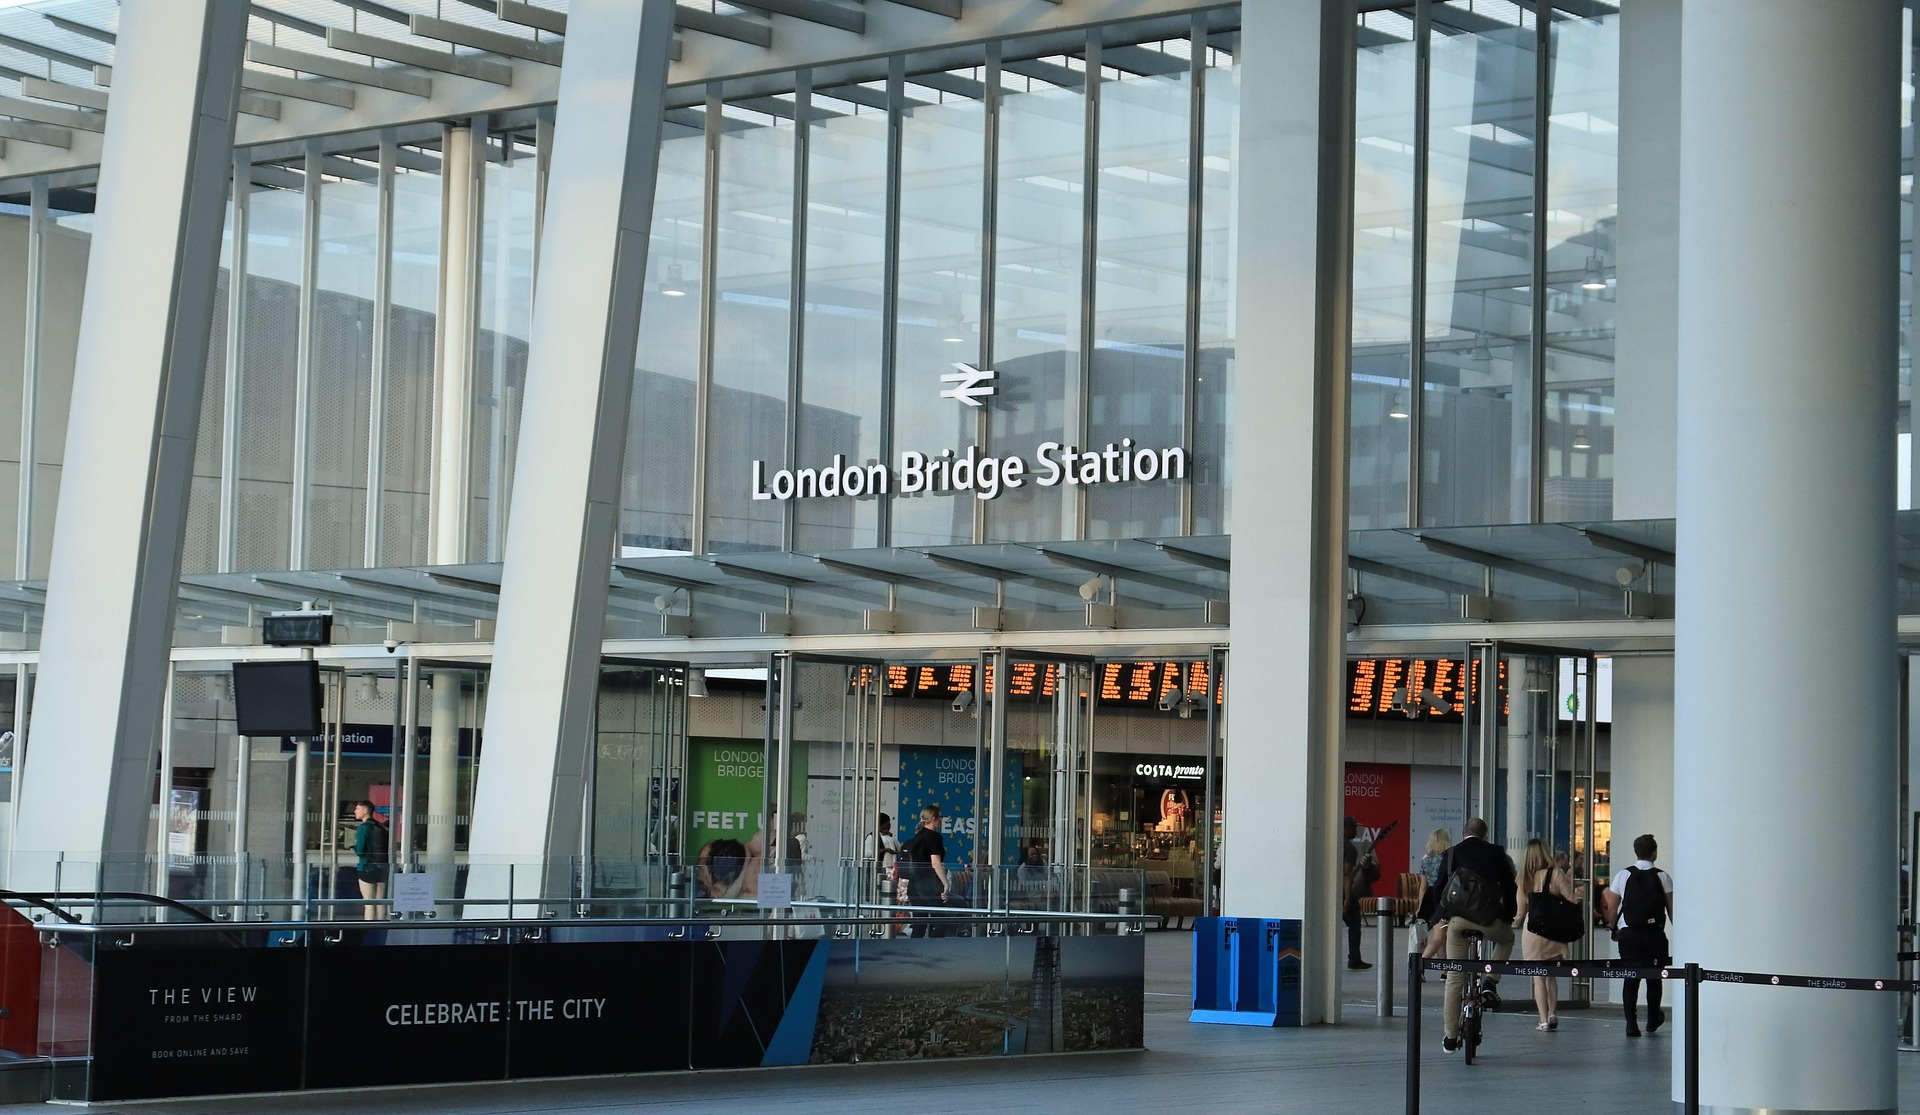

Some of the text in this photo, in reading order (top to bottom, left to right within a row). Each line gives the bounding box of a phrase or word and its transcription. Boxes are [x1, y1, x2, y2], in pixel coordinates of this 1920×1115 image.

[753, 437, 1185, 500] London Bridge Station
[935, 758, 976, 771] LONDO
[717, 765, 764, 778] BRIDGE
[938, 772, 975, 784] BRIDG
[1136, 764, 1205, 779] COSTA pronto
[1345, 786, 1380, 797] BRIDGE
[693, 811, 748, 829] FEET
[1603, 970, 1614, 978] THE
[149, 986, 257, 1005] THE VIEW
[165, 1013, 242, 1023] FROM THE SHARD
[385, 998, 606, 1026] CELEBRATE THE CITY
[152, 1046, 249, 1059] BOOK ONLINE AND SAVE
